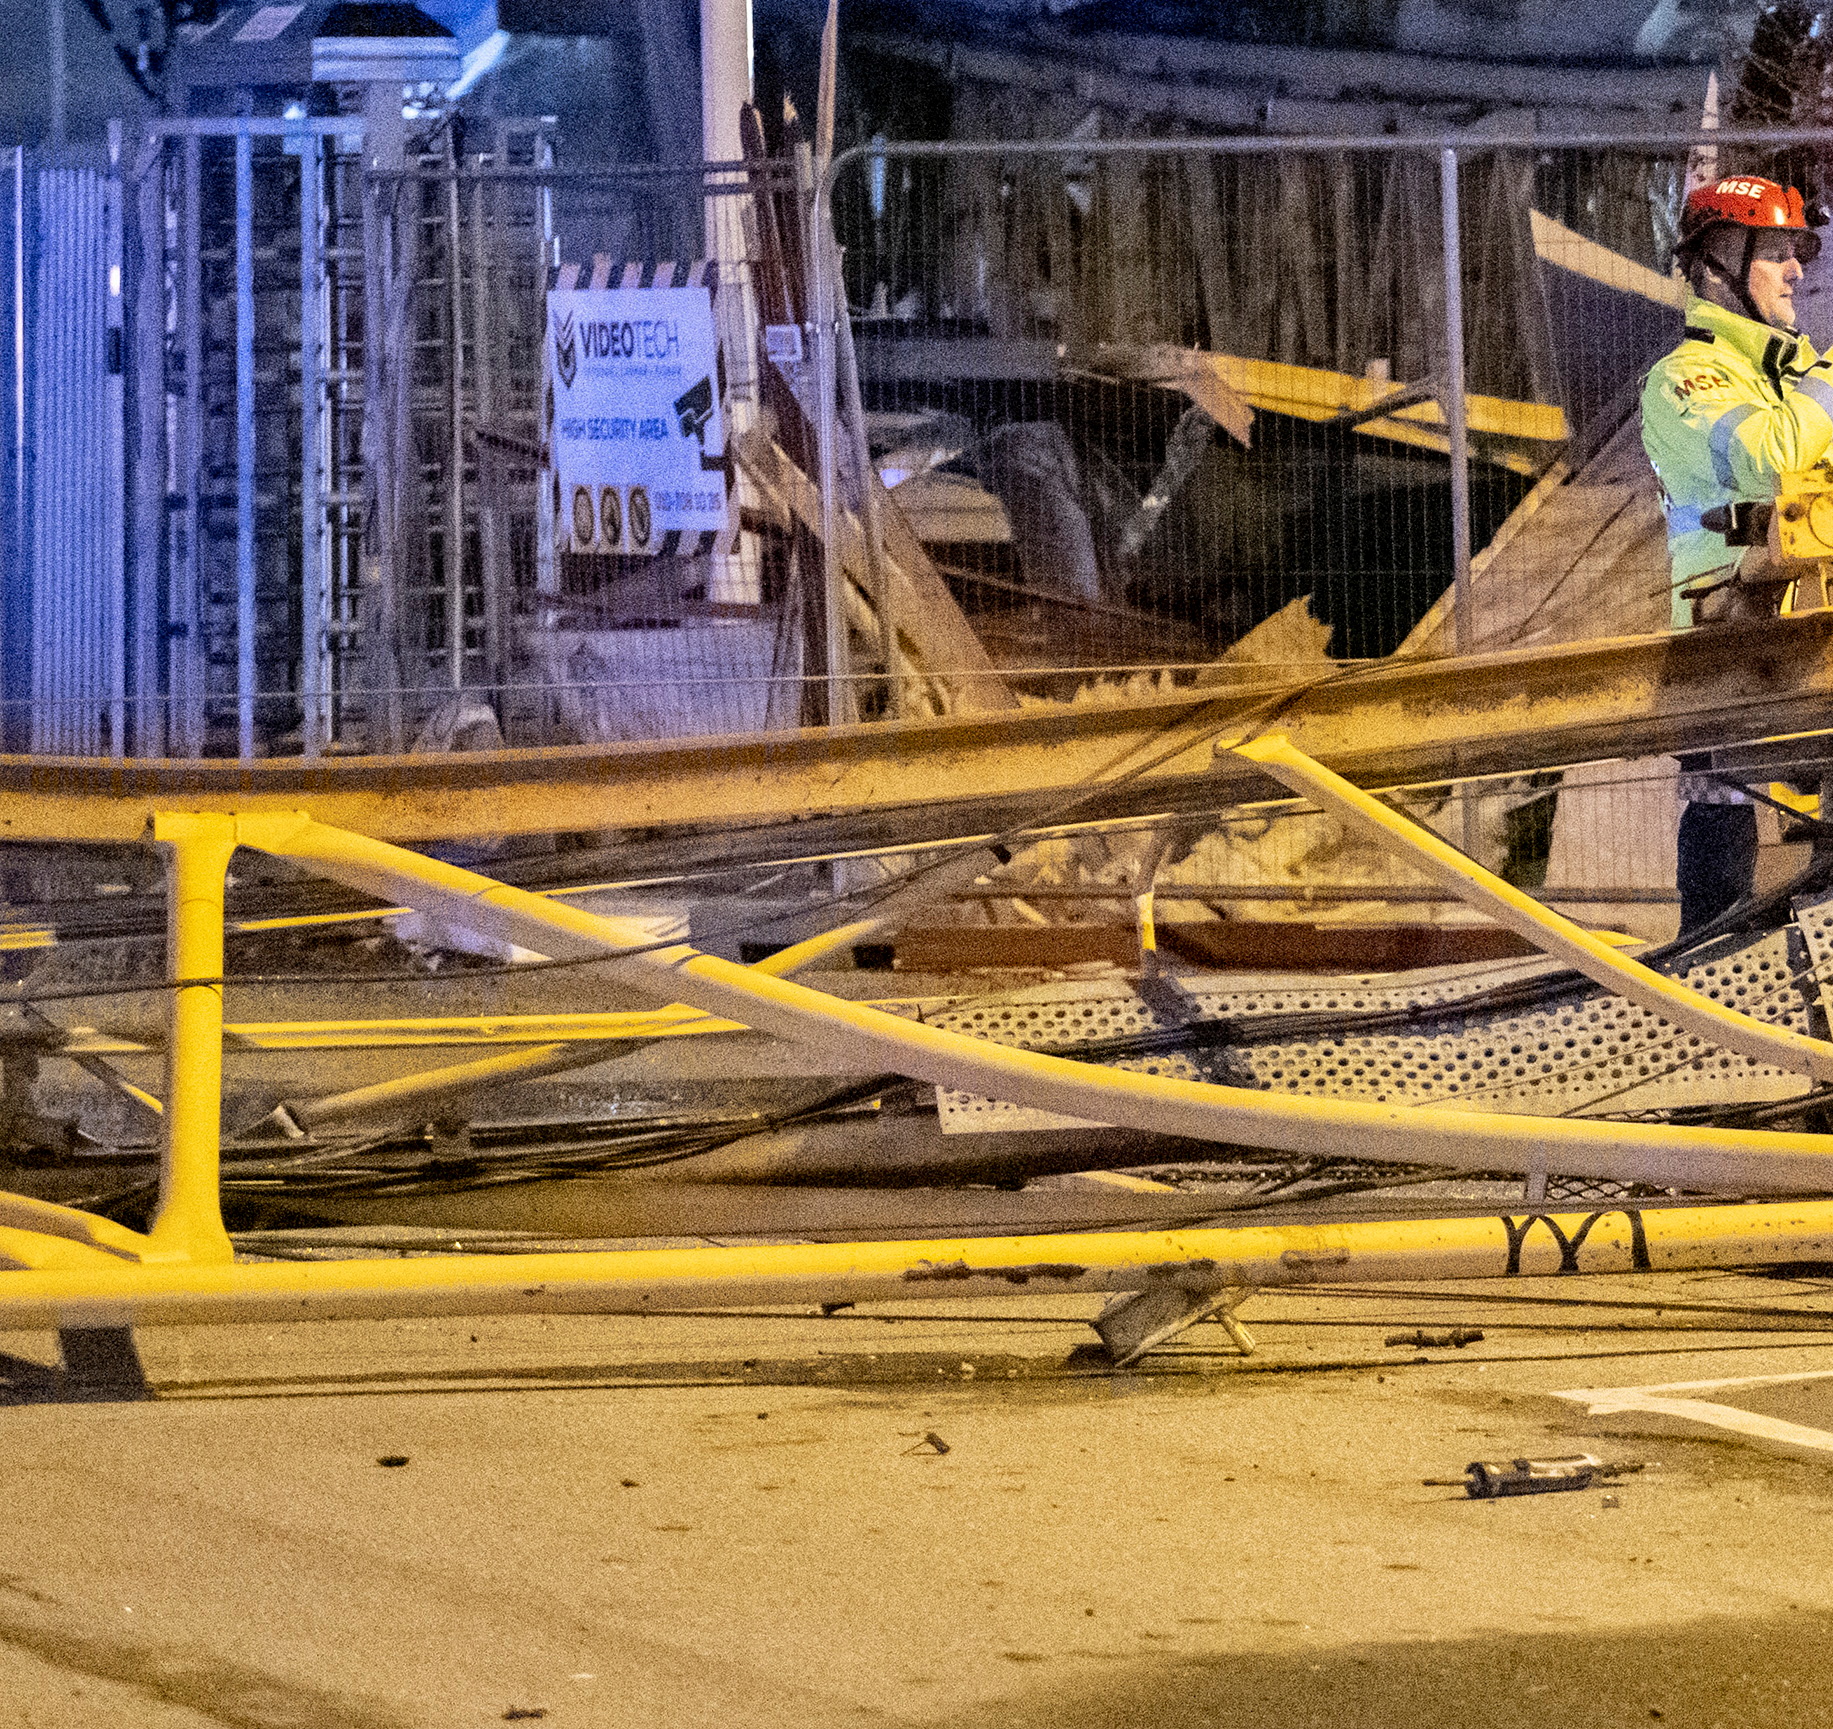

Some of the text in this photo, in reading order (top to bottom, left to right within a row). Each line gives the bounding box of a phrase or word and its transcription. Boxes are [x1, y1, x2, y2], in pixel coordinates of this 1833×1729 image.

[1716, 180, 1765, 199] MSE
[580, 321, 680, 359] VIDEOTECH
[1674, 374, 1730, 401] MSE
[588, 417, 636, 440] SECURITY
[638, 417, 669, 440] AREA
